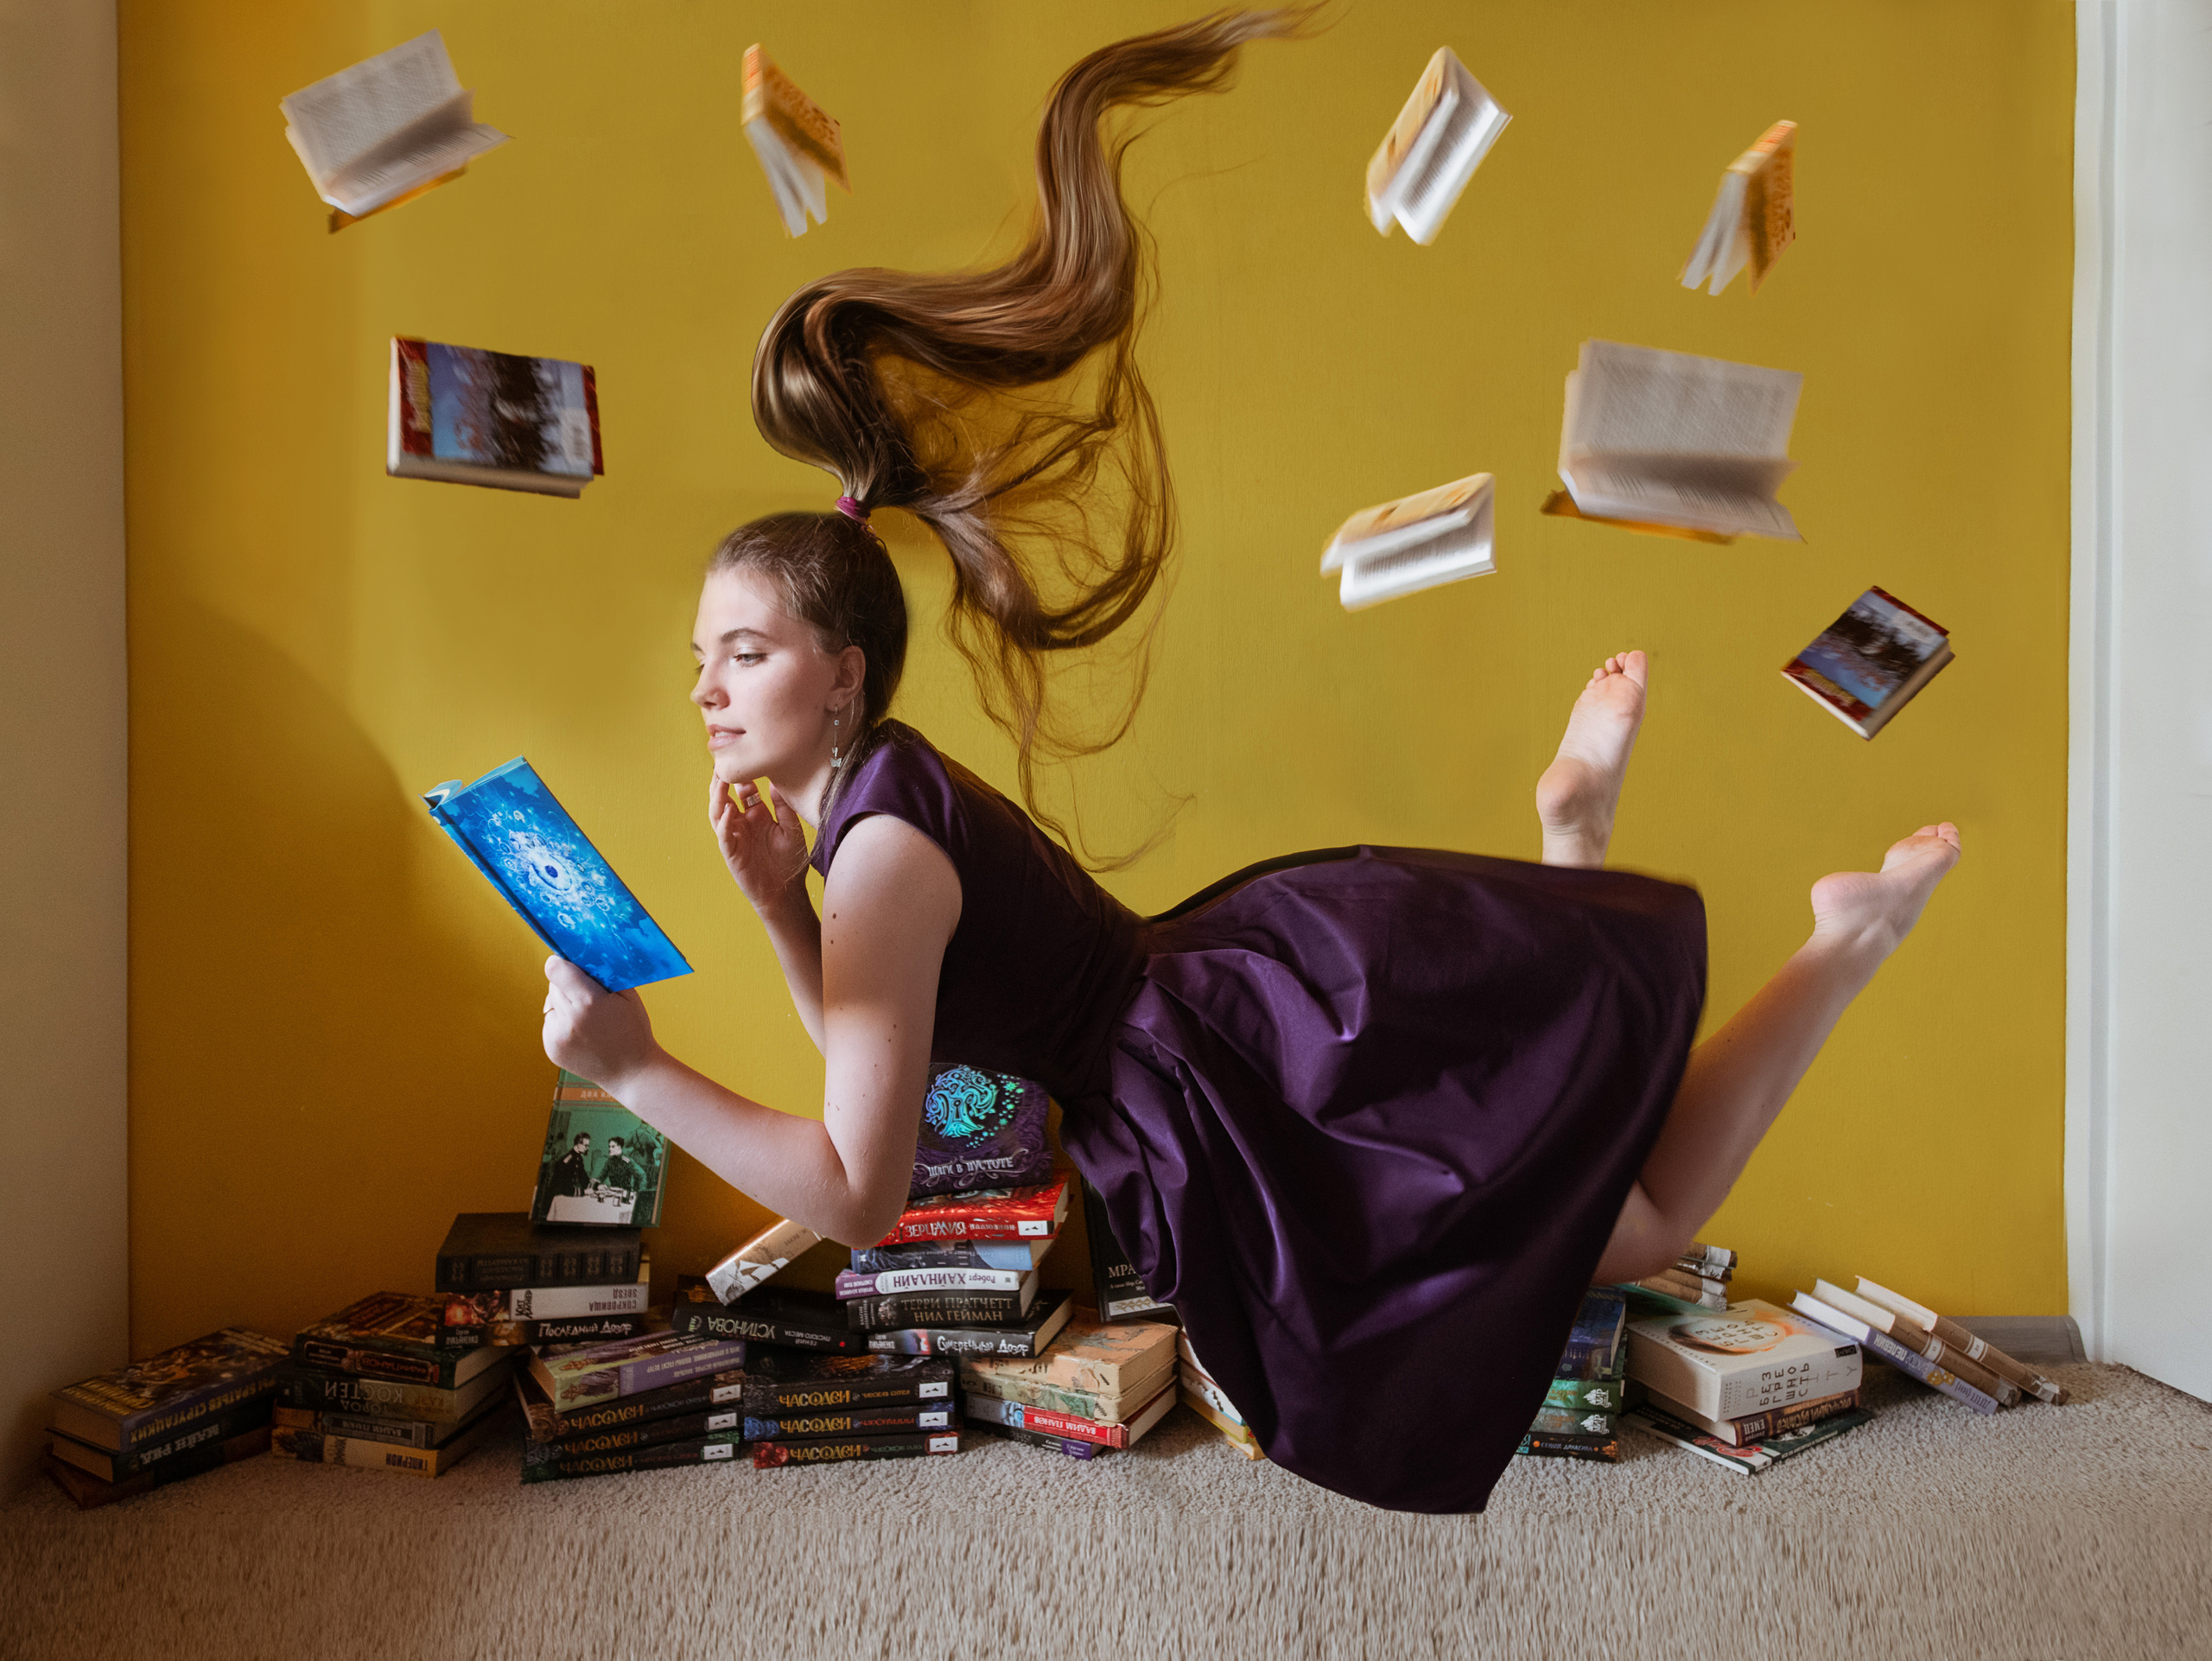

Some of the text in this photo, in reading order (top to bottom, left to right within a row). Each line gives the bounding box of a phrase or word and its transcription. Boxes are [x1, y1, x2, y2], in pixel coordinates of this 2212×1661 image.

[581, 1090, 598, 1098] ДВА
[927, 1156, 1014, 1177] ШАГИ В ПУСТОТЕ
[893, 1272, 995, 1289] Роберт ХАЙНЛАЙН
[588, 1300, 637, 1311] СОКРОВИЩА
[901, 1298, 1013, 1311] ТЕРРИ ПРАТЧЕТТ
[914, 1308, 1003, 1322] НИЛ ГЕЙМАН
[707, 1316, 776, 1340] УСТИНОВА
[804, 1332, 830, 1341] ПУСТОГО
[1873, 1333, 1908, 1361] ПЕЛЕВИН
[646, 1362, 660, 1372] ВЕТЕР
[208, 1381, 257, 1413] БРАТЬЕВ
[325, 1380, 404, 1403] КОСТЕЙ
[779, 1390, 850, 1408] ЧАСОДЕИ
[340, 1400, 387, 1415] ГОРОД
[129, 1400, 207, 1444] СТРУГАЦКИХ
[570, 1404, 645, 1429] ЧАСОДЕИ
[780, 1417, 851, 1433] ЧАСОДЕИ
[1033, 1416, 1096, 1435] ВАДИМ ПАНОВ
[1743, 1418, 1765, 1435] ЕМЕЦ
[138, 1423, 219, 1465] МАЙН РИД
[564, 1431, 639, 1454] ЧАСОДЕИ
[385, 1453, 429, 1470] ГИПЕРИОН
[790, 1445, 861, 1461] ЧАСОДЕИ
[559, 1454, 633, 1473] ЧАСОДЕИ
